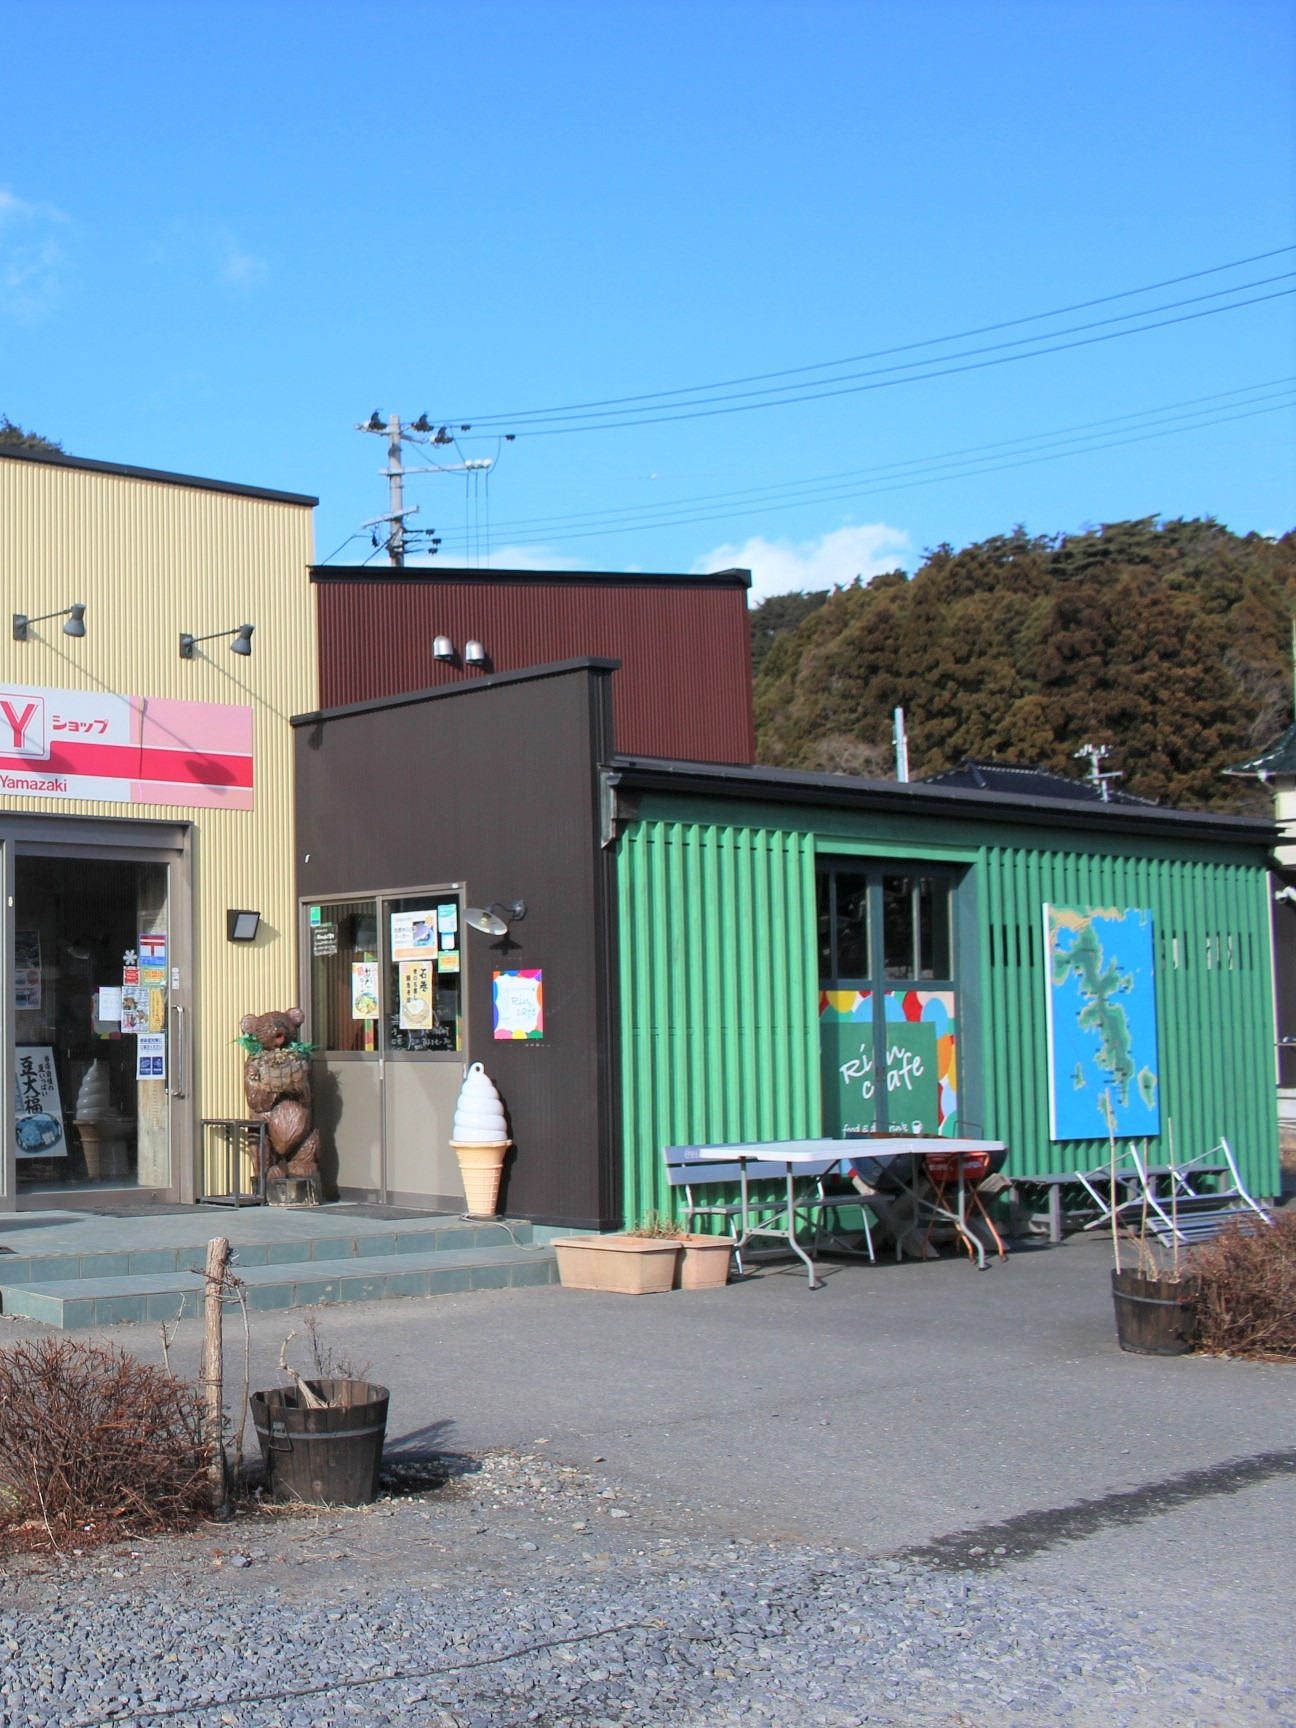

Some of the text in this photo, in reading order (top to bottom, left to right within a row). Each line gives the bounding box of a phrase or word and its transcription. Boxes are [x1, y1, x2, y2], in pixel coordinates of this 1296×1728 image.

[0, 700, 39, 749] Y
[52, 714, 109, 735] ショップ
[0, 774, 67, 793] Yamazaki
[19, 1055, 44, 1115] 豆大福
